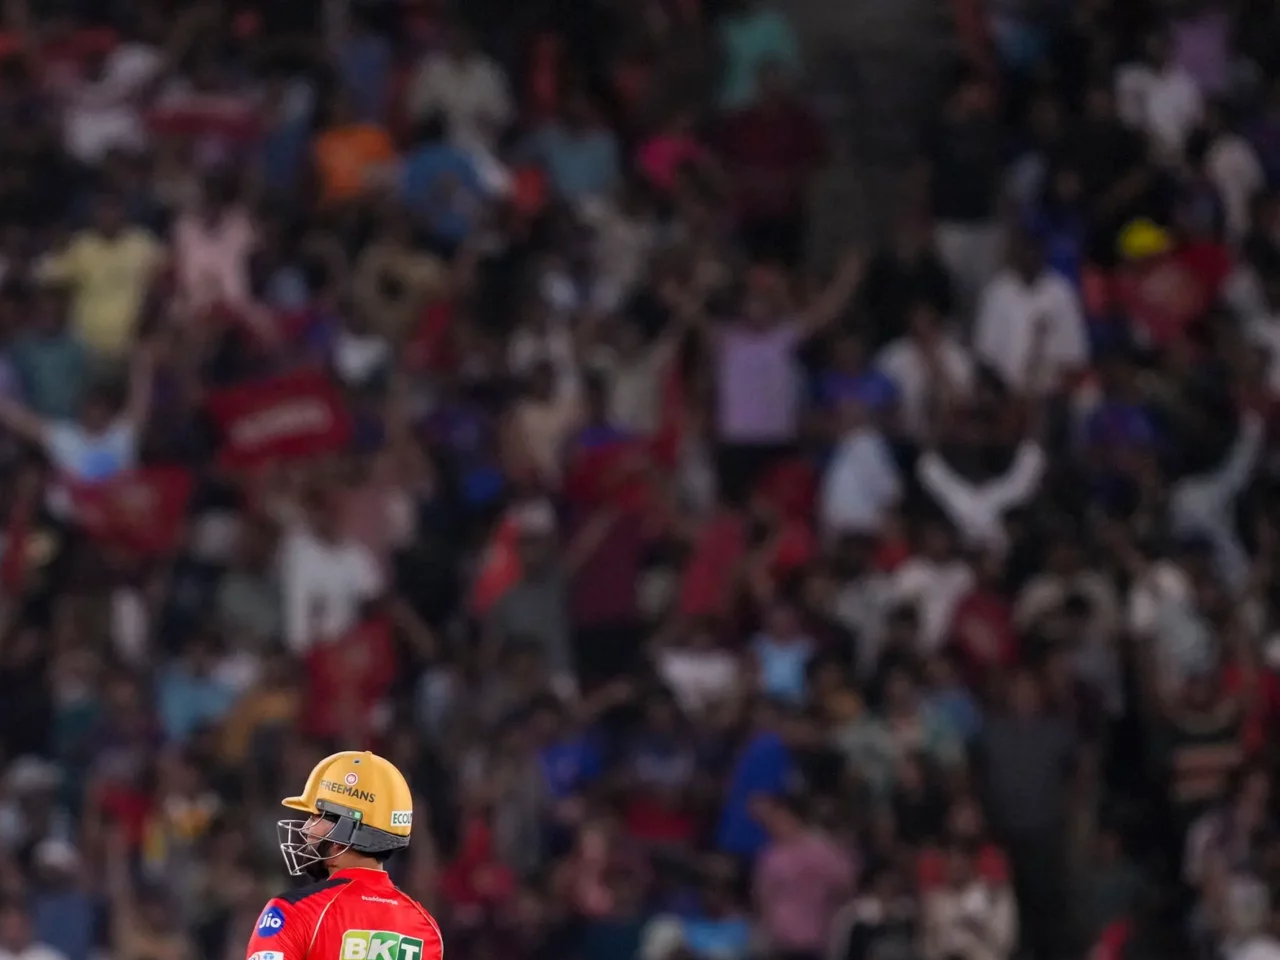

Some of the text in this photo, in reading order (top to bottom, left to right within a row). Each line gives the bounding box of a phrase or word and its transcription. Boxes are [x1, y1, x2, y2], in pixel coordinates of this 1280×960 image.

[321, 779, 376, 803] FREEMANS
[392, 812, 412, 825] ECOL
[259, 913, 281, 928] Jio
